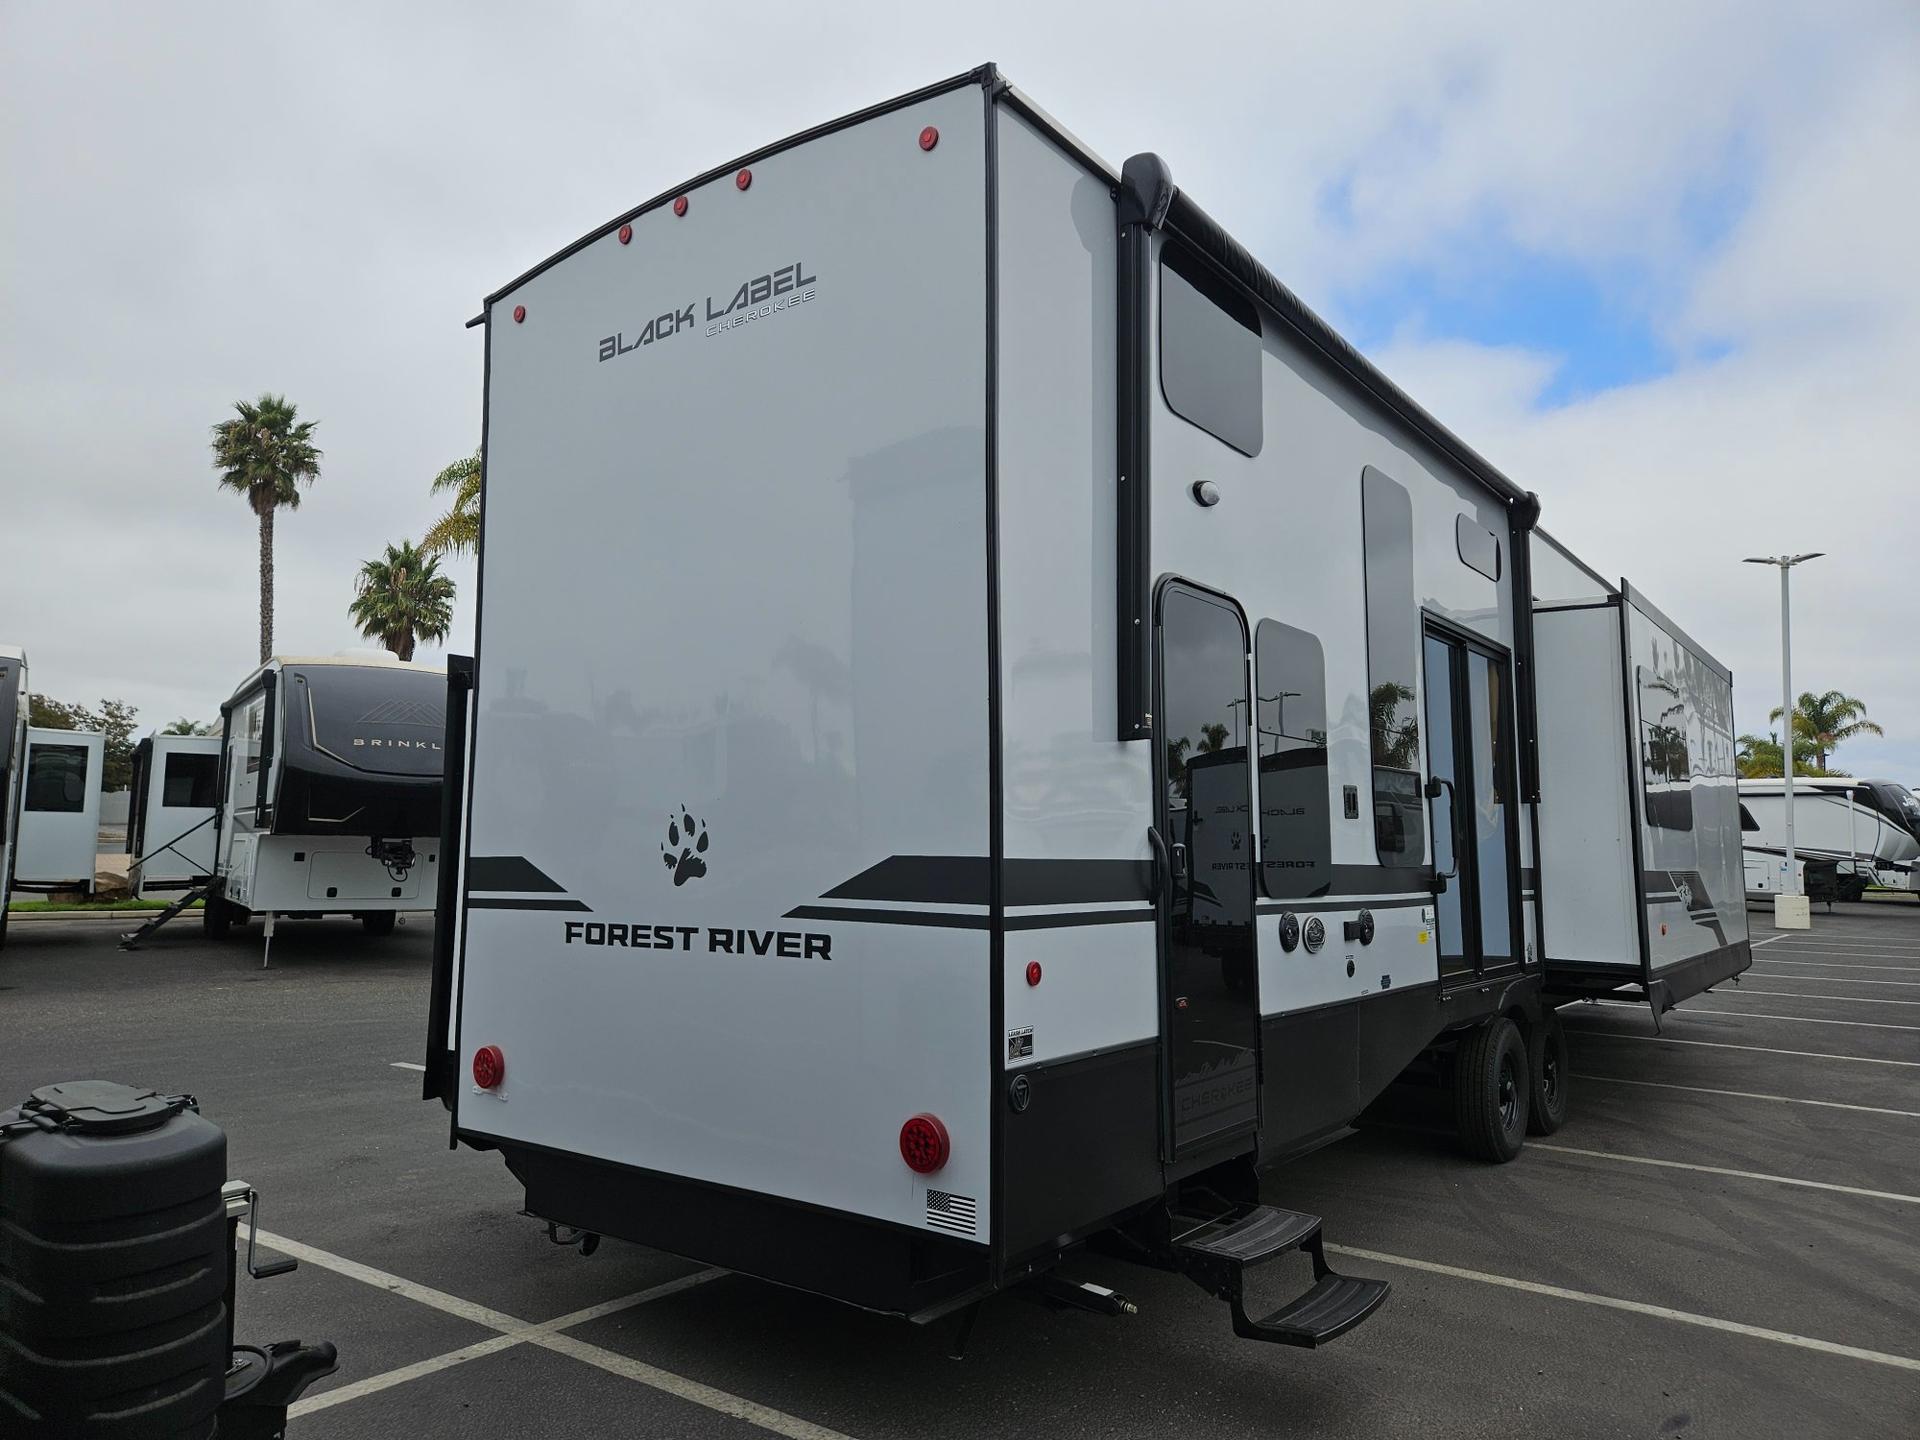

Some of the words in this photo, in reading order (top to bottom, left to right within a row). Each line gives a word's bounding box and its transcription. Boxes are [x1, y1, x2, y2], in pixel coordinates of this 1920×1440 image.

[599, 303, 696, 362] BLACK
[706, 262, 817, 322] LABEL
[705, 288, 816, 338] CHEROKEE
[565, 921, 699, 951] FOREST
[707, 927, 832, 961] RIVER
